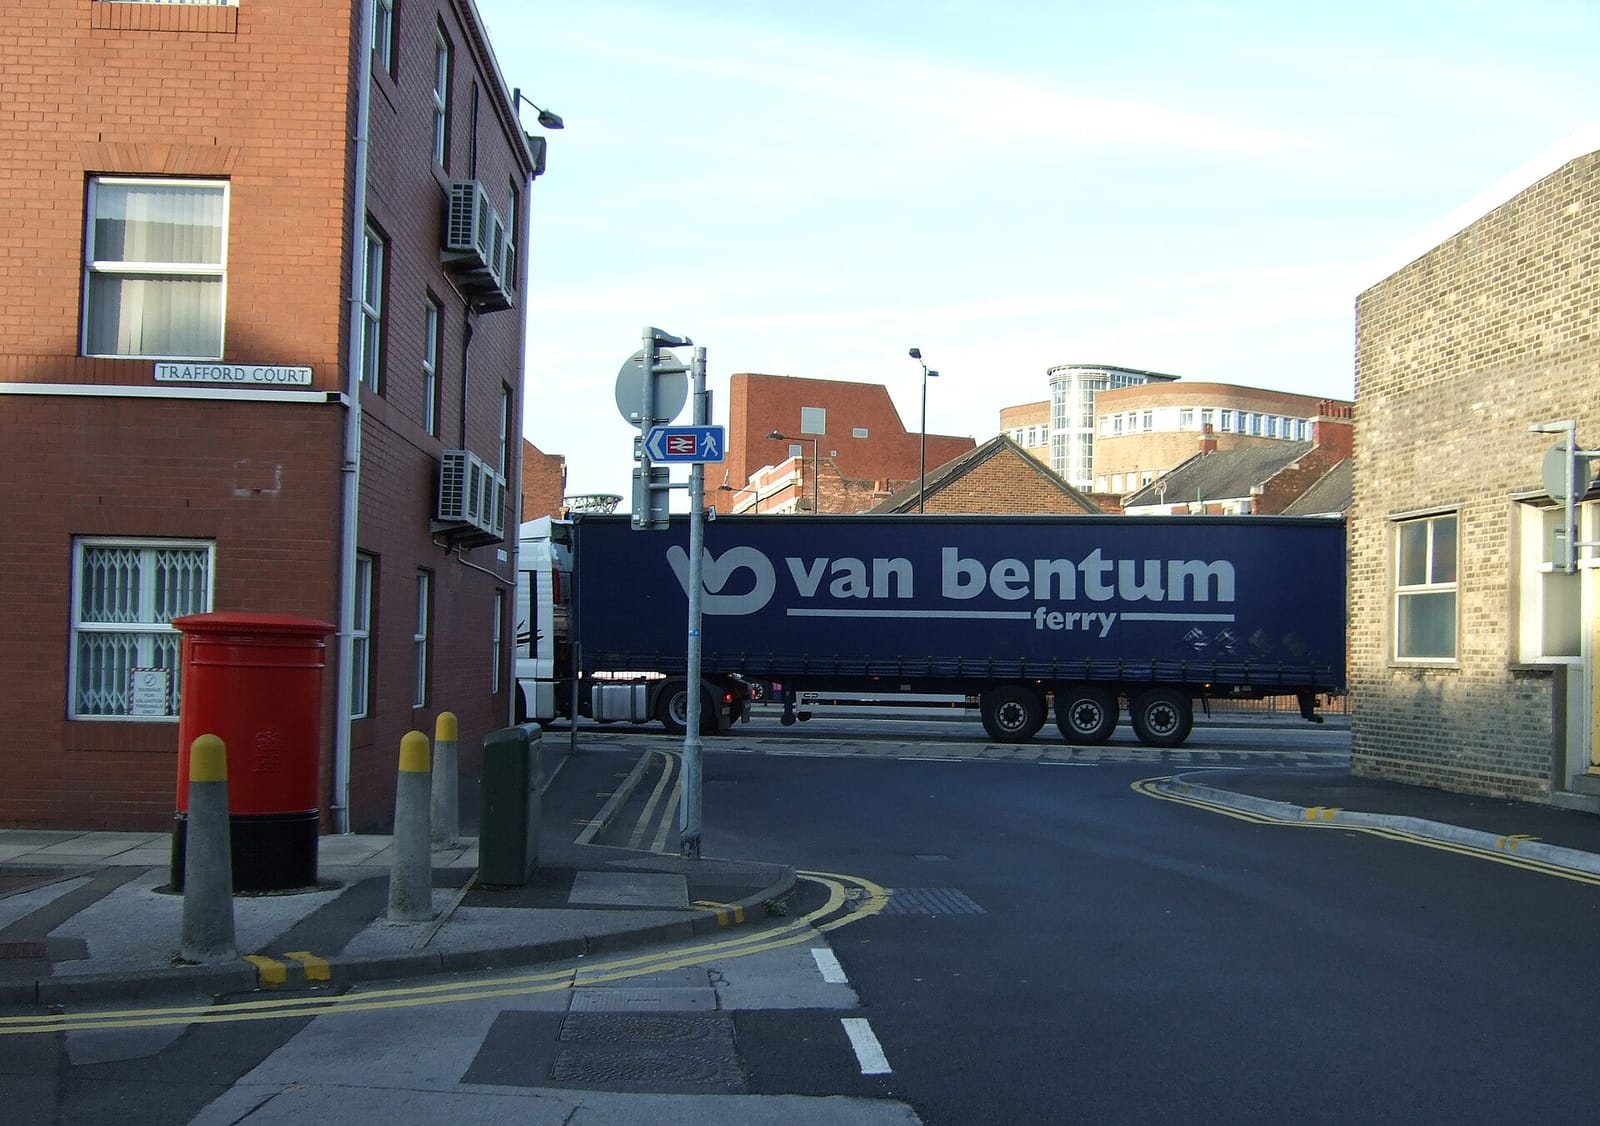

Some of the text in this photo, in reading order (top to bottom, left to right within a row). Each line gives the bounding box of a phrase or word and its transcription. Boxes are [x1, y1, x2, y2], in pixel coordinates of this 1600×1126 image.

[159, 365, 308, 382] TRAFFORD COURT
[784, 547, 1235, 602] van bentum
[1033, 606, 1118, 638] ferry
